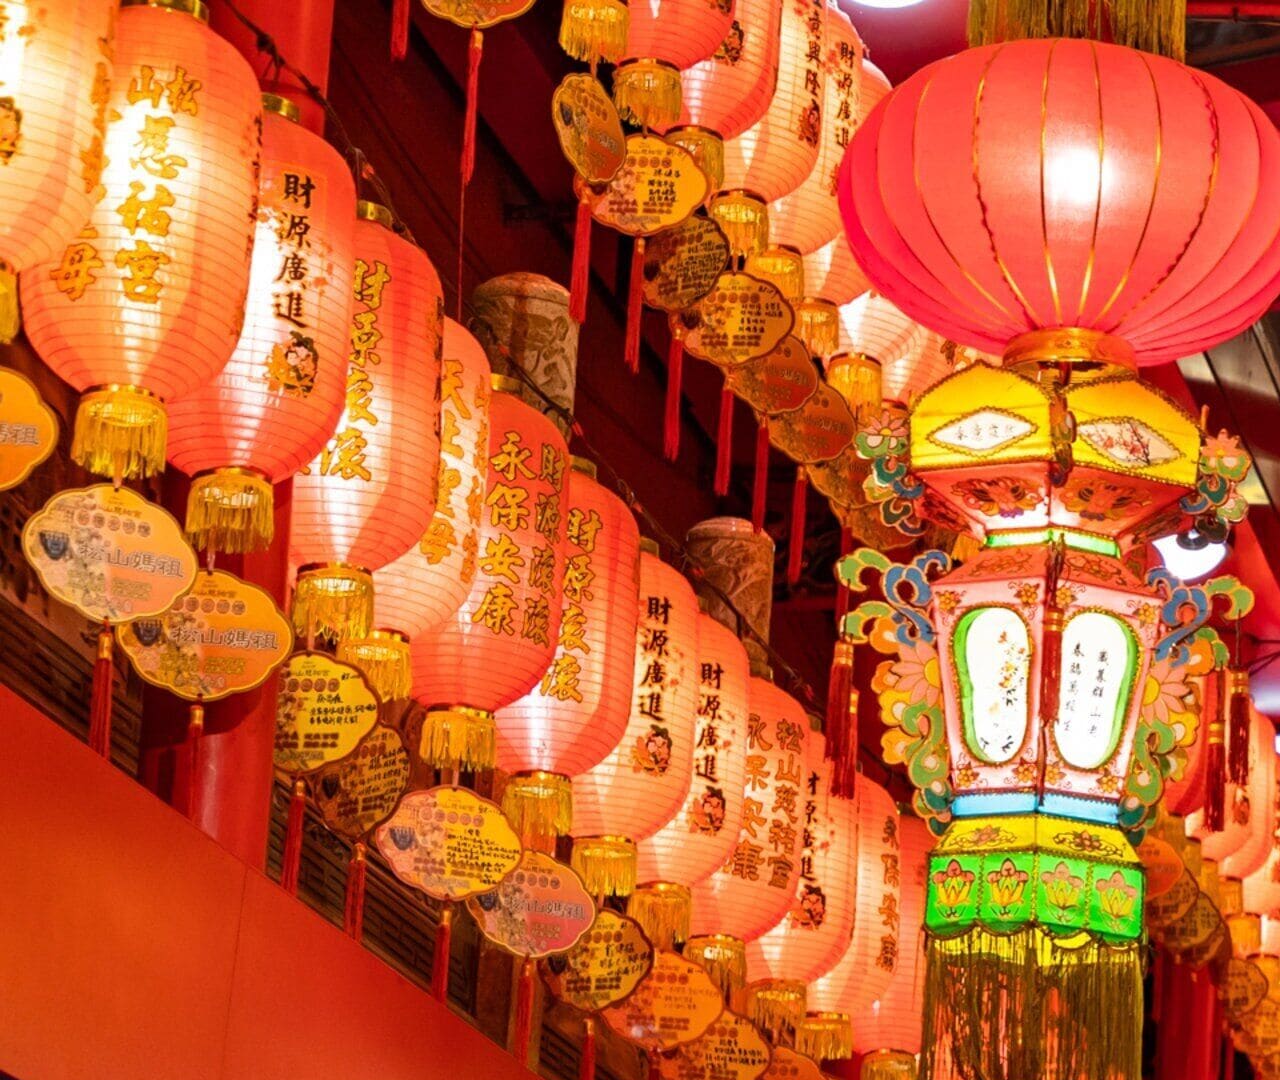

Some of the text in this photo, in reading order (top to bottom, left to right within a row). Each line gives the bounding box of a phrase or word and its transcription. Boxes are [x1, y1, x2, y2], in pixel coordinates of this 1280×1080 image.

[804, 0, 823, 97] 意興隆
[273, 172, 317, 329] 財源廣進
[77, 540, 185, 579] 松山媽祖
[471, 431, 537, 636] 永保安康
[521, 442, 567, 649] 財源滾滾
[171, 625, 280, 651] 松山媽祖
[637, 595, 674, 723] 財源廣進
[694, 661, 725, 785] 財源廣進
